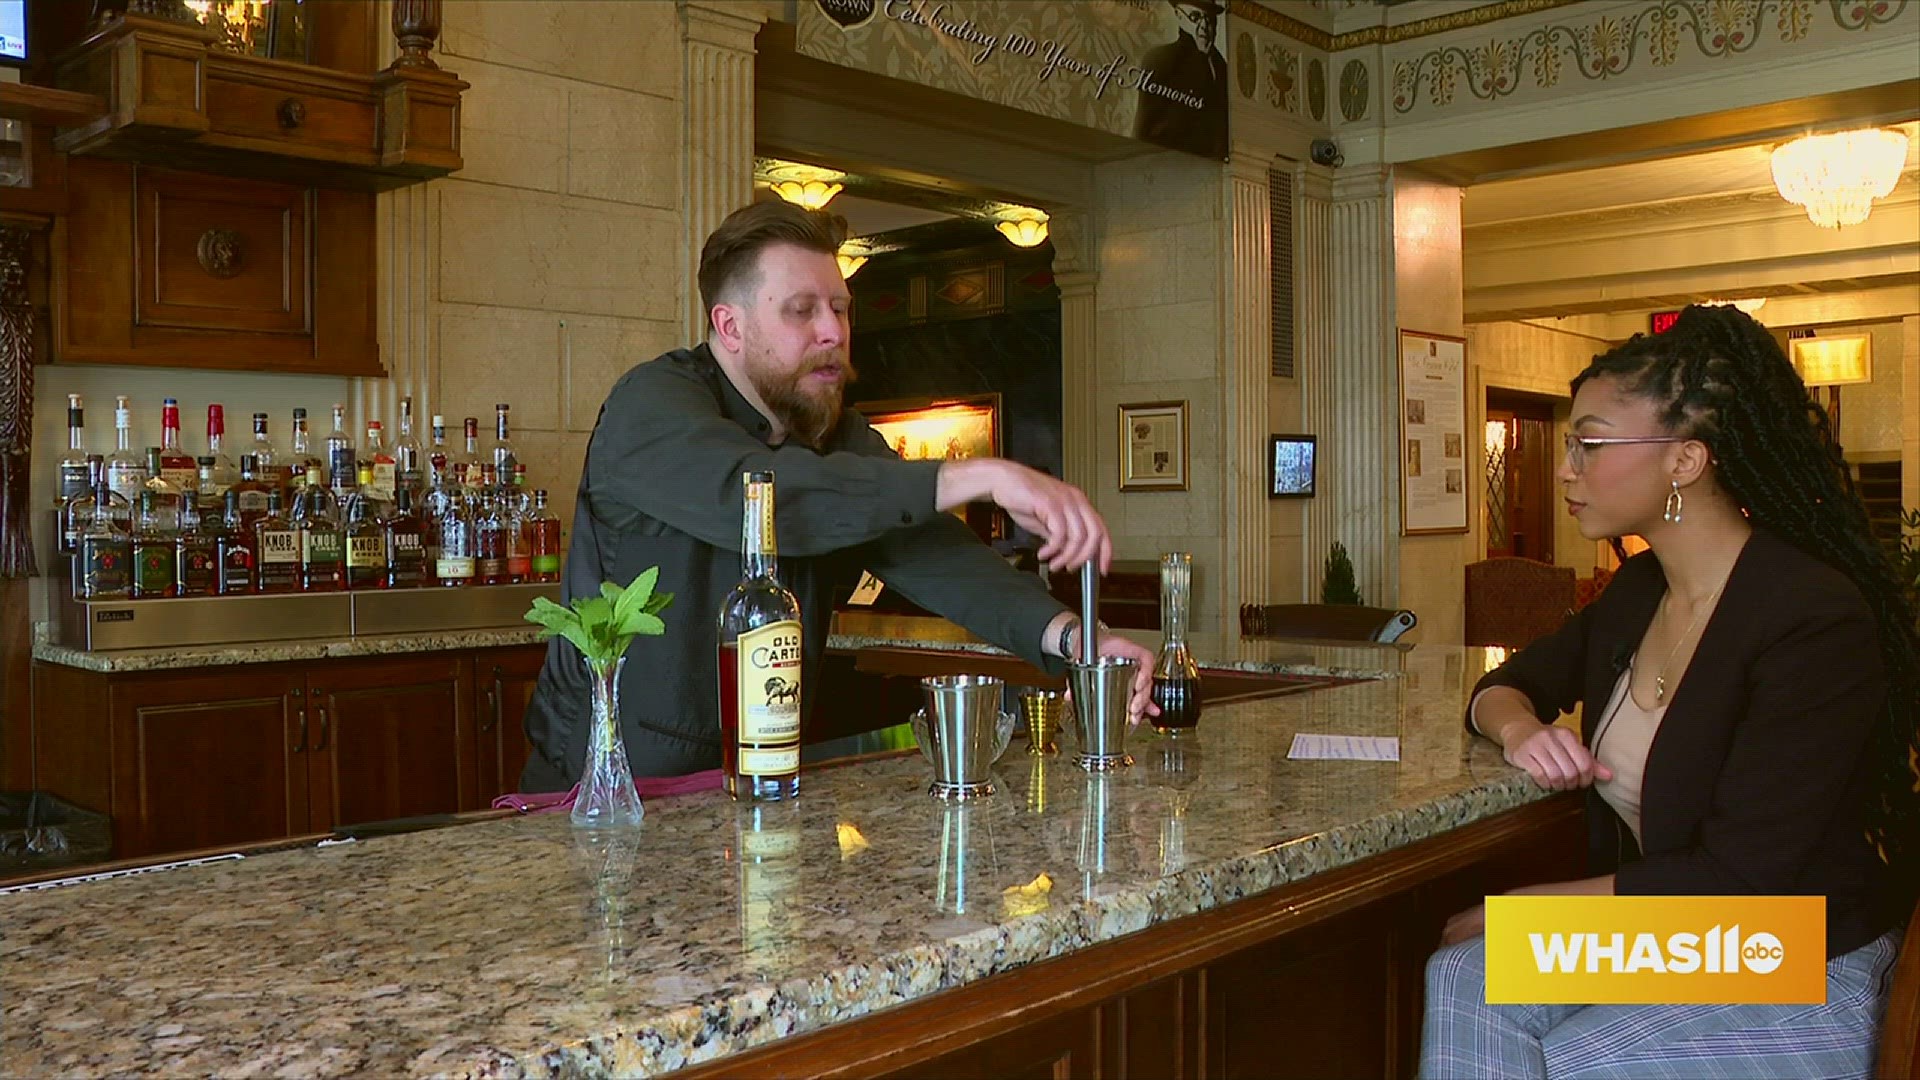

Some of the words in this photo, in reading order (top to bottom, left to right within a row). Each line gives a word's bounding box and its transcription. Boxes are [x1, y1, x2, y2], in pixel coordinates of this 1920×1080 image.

[884, 0, 999, 65] Celebrating
[1003, 33, 1037, 57] 100
[1038, 39, 1092, 81] Years
[1095, 55, 1127, 99] of
[1118, 67, 1204, 109] Memories
[265, 534, 292, 547] KNOB
[310, 534, 337, 547] KNOB
[352, 538, 379, 551] KNOB
[394, 533, 419, 545] KNOB
[773, 636, 798, 647] OLD
[752, 646, 800, 669] CARTE
